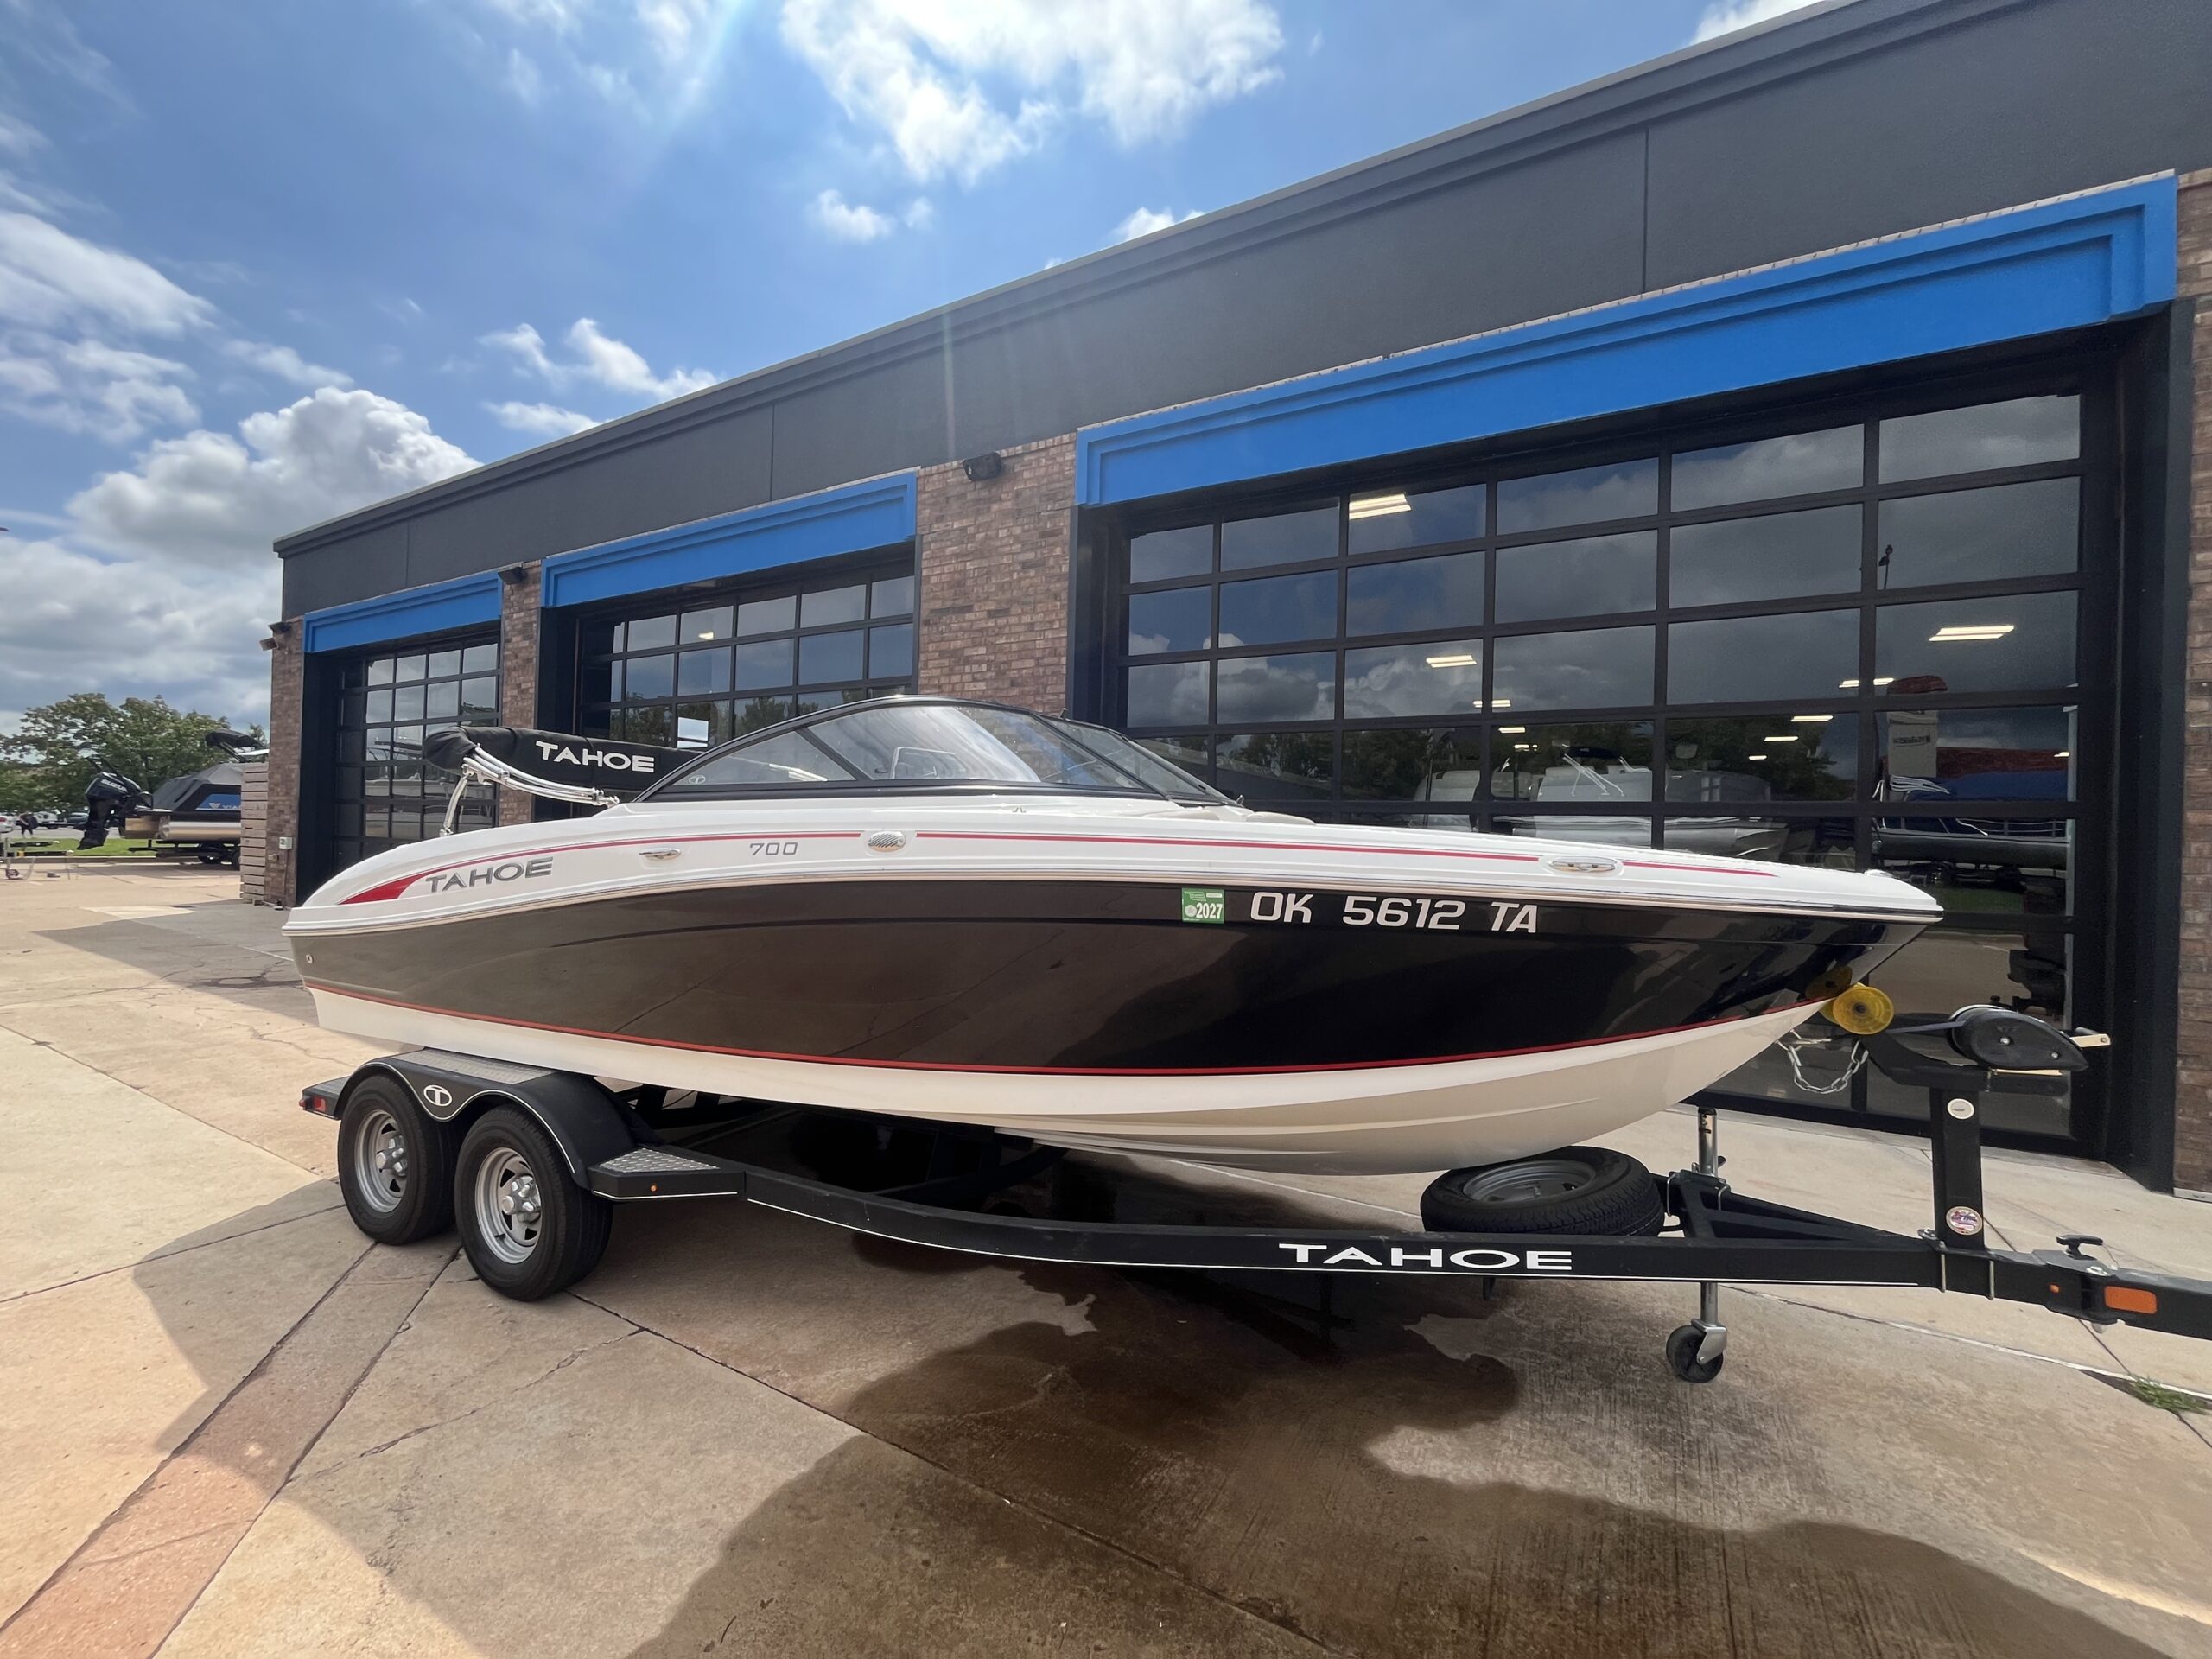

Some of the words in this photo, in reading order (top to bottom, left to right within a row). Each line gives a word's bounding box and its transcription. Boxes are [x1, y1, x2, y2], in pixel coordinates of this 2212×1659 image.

[536, 741, 654, 772] TAHOE
[749, 842, 798, 855] 700
[425, 856, 554, 893] TAHOE
[1195, 902, 1224, 920] 2027
[1250, 891, 1314, 924] OK
[1342, 895, 1466, 931] 5612
[1491, 901, 1538, 934] TA
[1278, 1243, 1573, 1271] TAHOE
